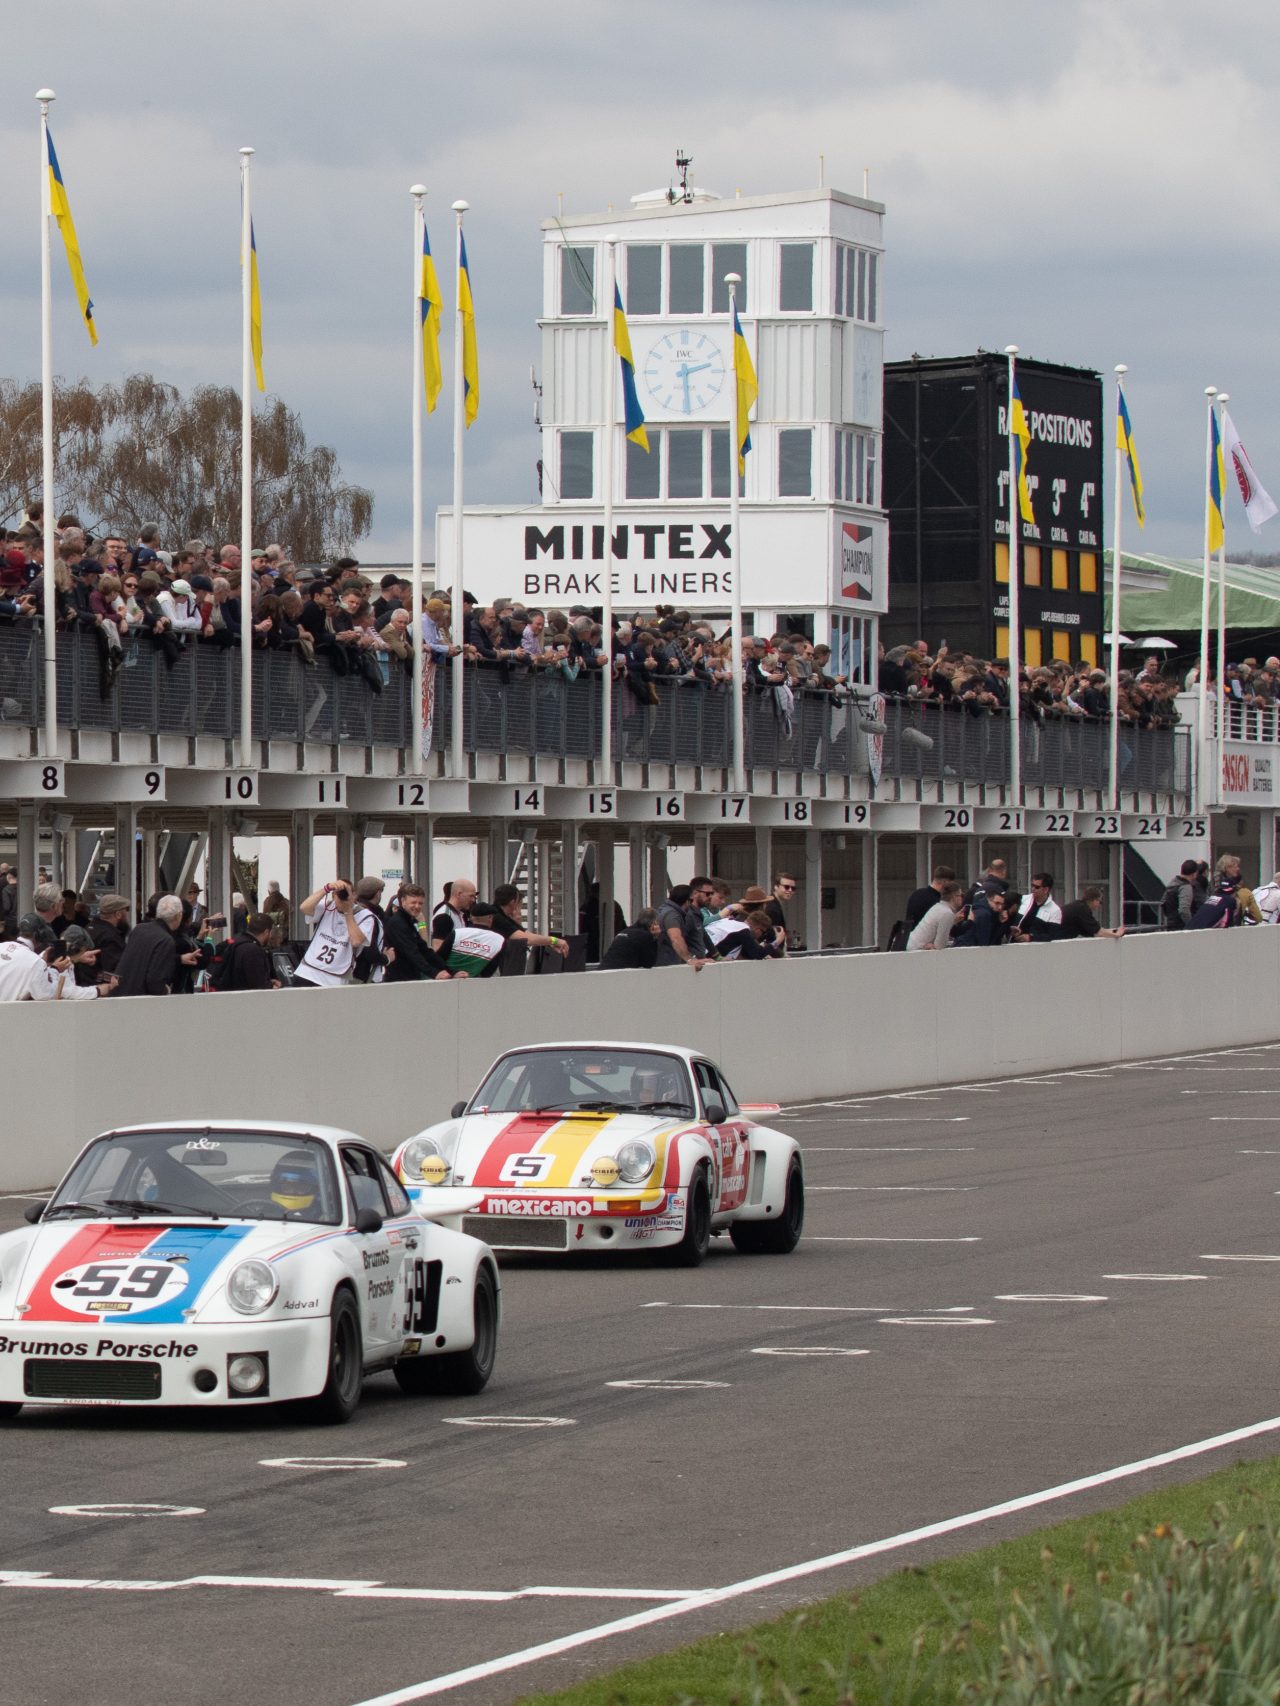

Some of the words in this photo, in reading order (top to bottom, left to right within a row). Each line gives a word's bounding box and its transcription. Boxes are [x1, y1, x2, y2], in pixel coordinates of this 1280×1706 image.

[676, 350, 694, 359] IWC
[1031, 411, 1092, 449] POSITIONS
[524, 524, 732, 560] MINTEX
[843, 548, 873, 576] CHAMPION
[524, 573, 620, 595] BRAKE
[634, 572, 732, 594] LINERS
[42, 766, 58, 791] 8
[145, 771, 160, 795] 9
[225, 776, 253, 800] 10
[318, 780, 340, 803] 11
[398, 784, 424, 806] 12
[515, 789, 539, 811] 14
[589, 793, 612, 814] 15
[655, 796, 680, 816] 16
[721, 799, 744, 818] 17
[784, 802, 807, 821] 18
[844, 805, 866, 824] 19
[945, 809, 969, 828] 20
[999, 812, 1021, 830] 21
[1046, 814, 1069, 832] 22
[1095, 816, 1117, 834] 23
[1138, 818, 1161, 836] 24
[1182, 820, 1205, 837] 25
[316, 944, 338, 965] 25
[459, 940, 491, 953] HISTORICS
[186, 1137, 221, 1151] D&P
[510, 1156, 547, 1178] 5
[487, 1198, 592, 1216] mexicano
[624, 1216, 657, 1228] union
[657, 1219, 682, 1227] CHAMPION
[363, 1250, 390, 1271] Brumos
[72, 1265, 174, 1298] 59
[368, 1275, 395, 1301] Porsche
[283, 1299, 319, 1310] Addval
[96, 1339, 199, 1358] Porsche
